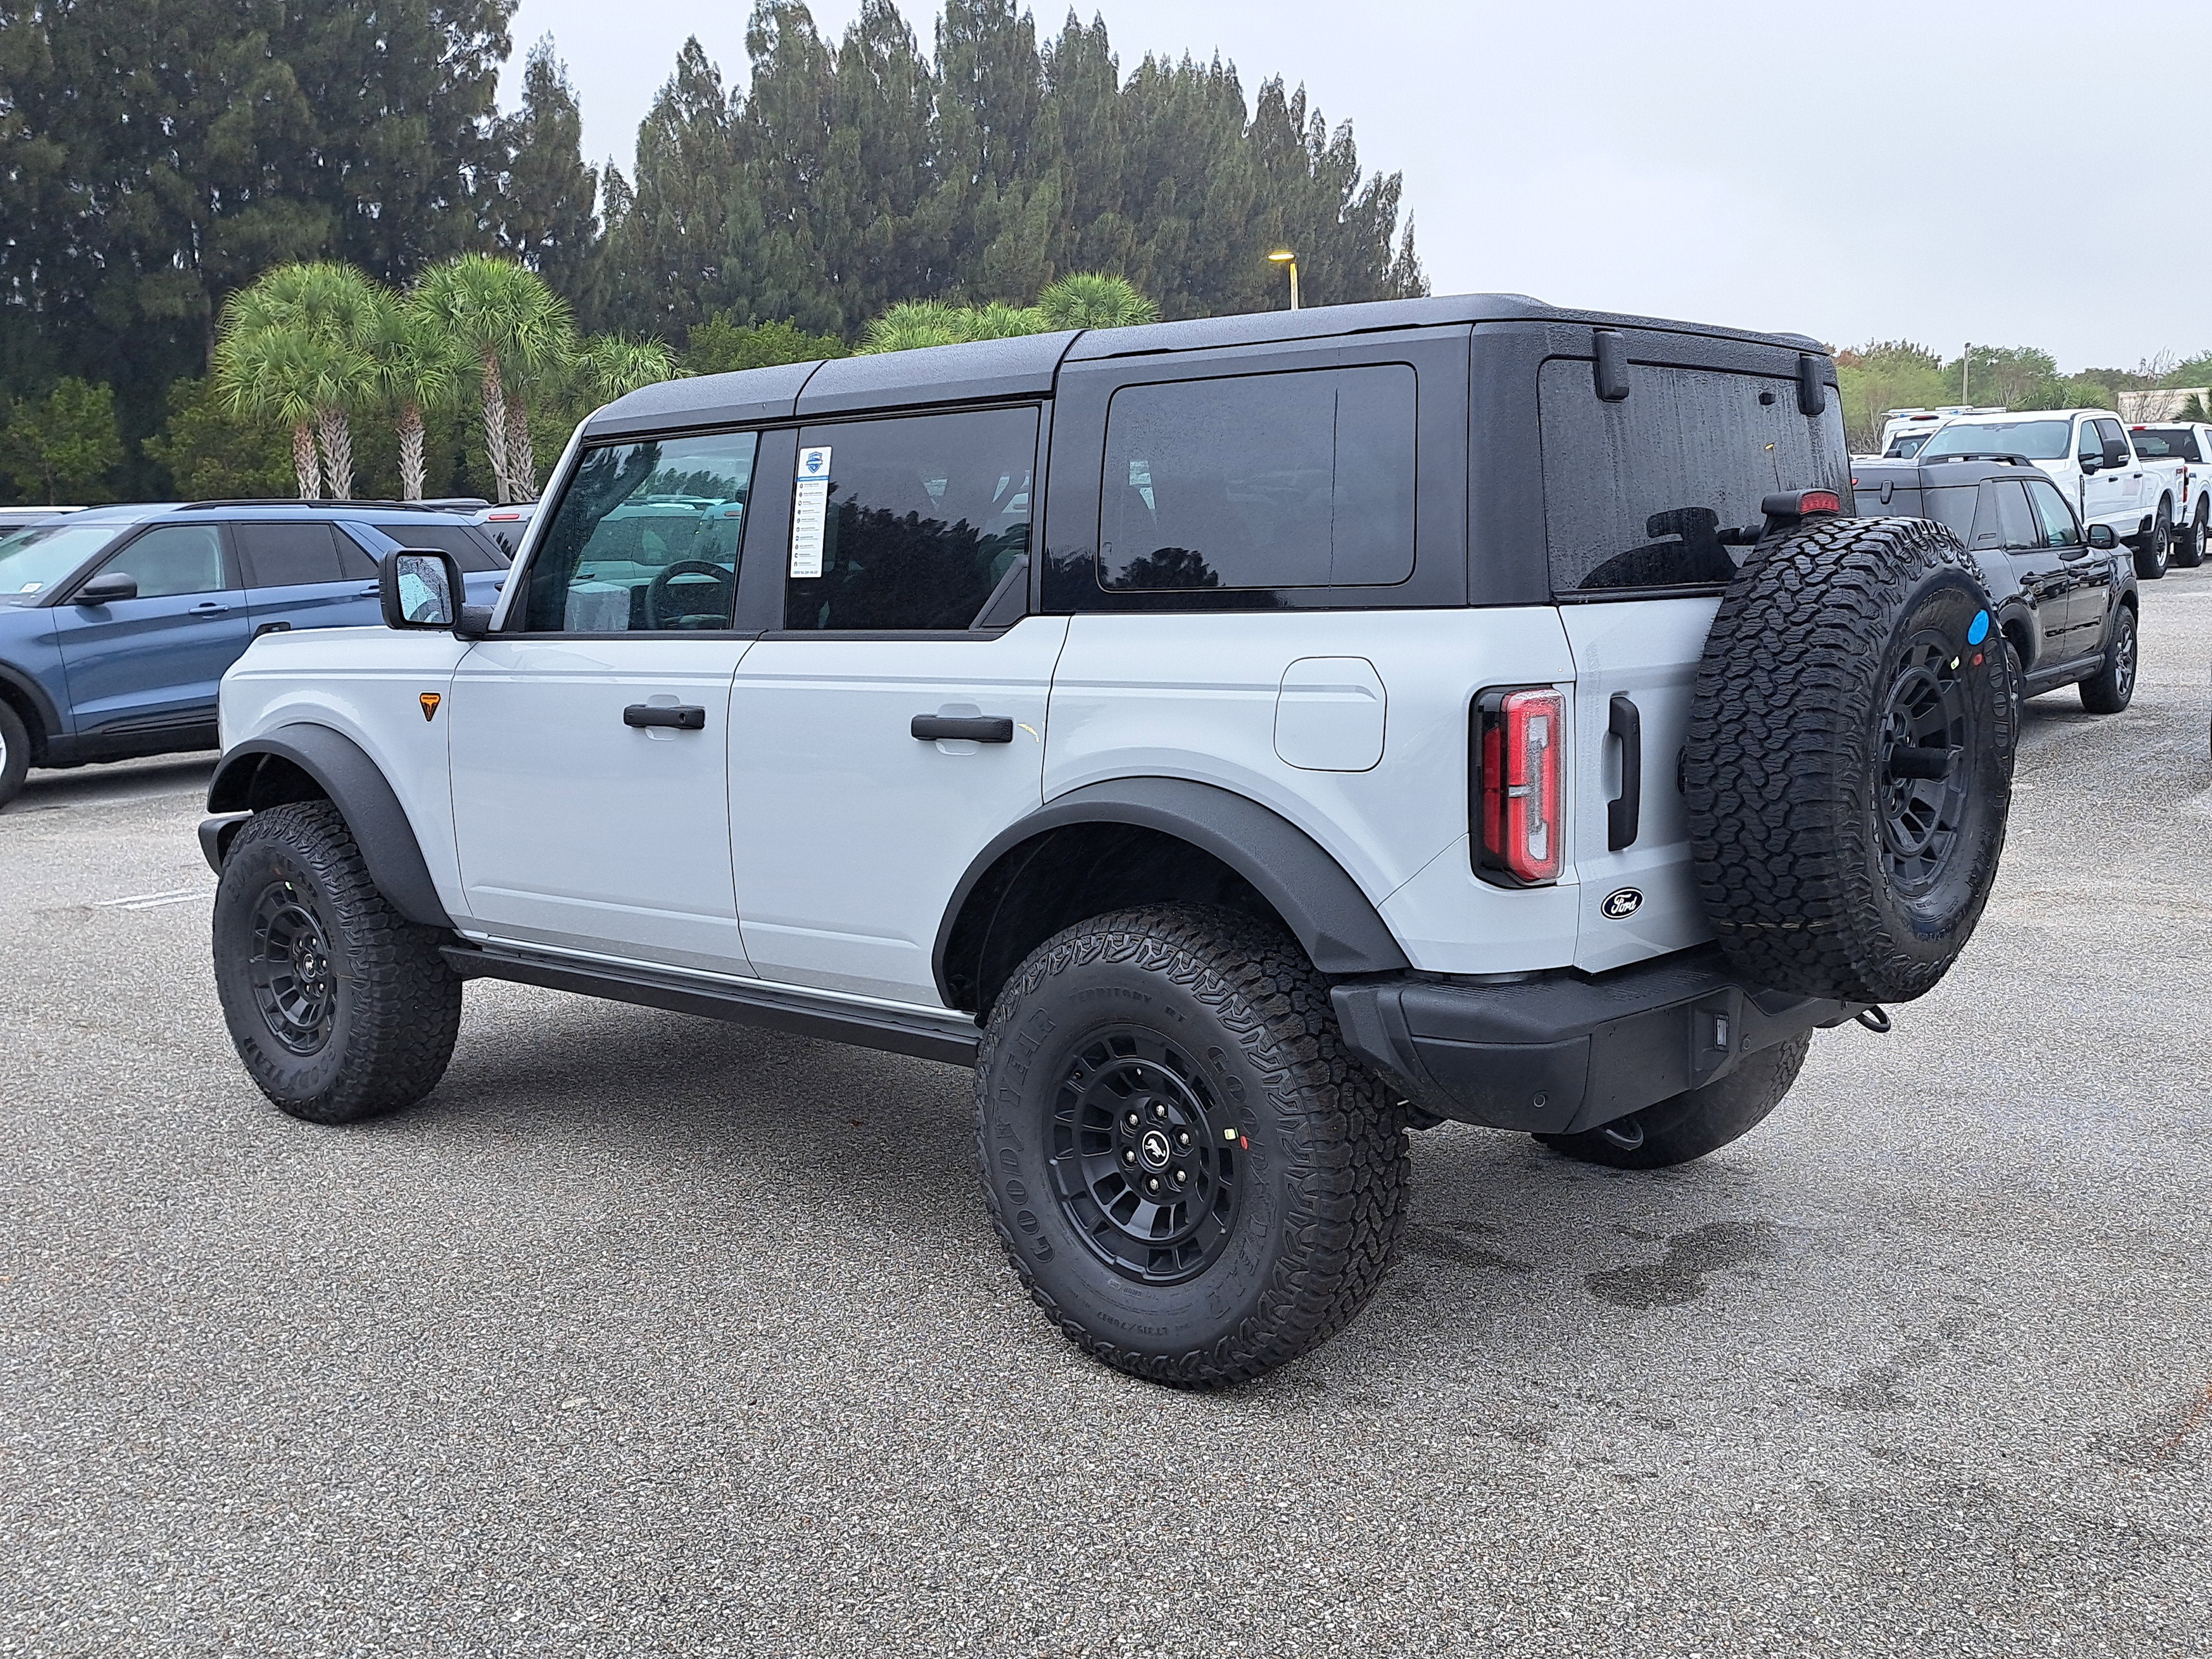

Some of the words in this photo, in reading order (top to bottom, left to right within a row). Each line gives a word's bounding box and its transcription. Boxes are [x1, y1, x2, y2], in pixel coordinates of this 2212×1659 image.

[1611, 893, 1637, 914] Ford
[1164, 1005, 1186, 1024] RT
[992, 1007, 1056, 1263] GOODYEAR
